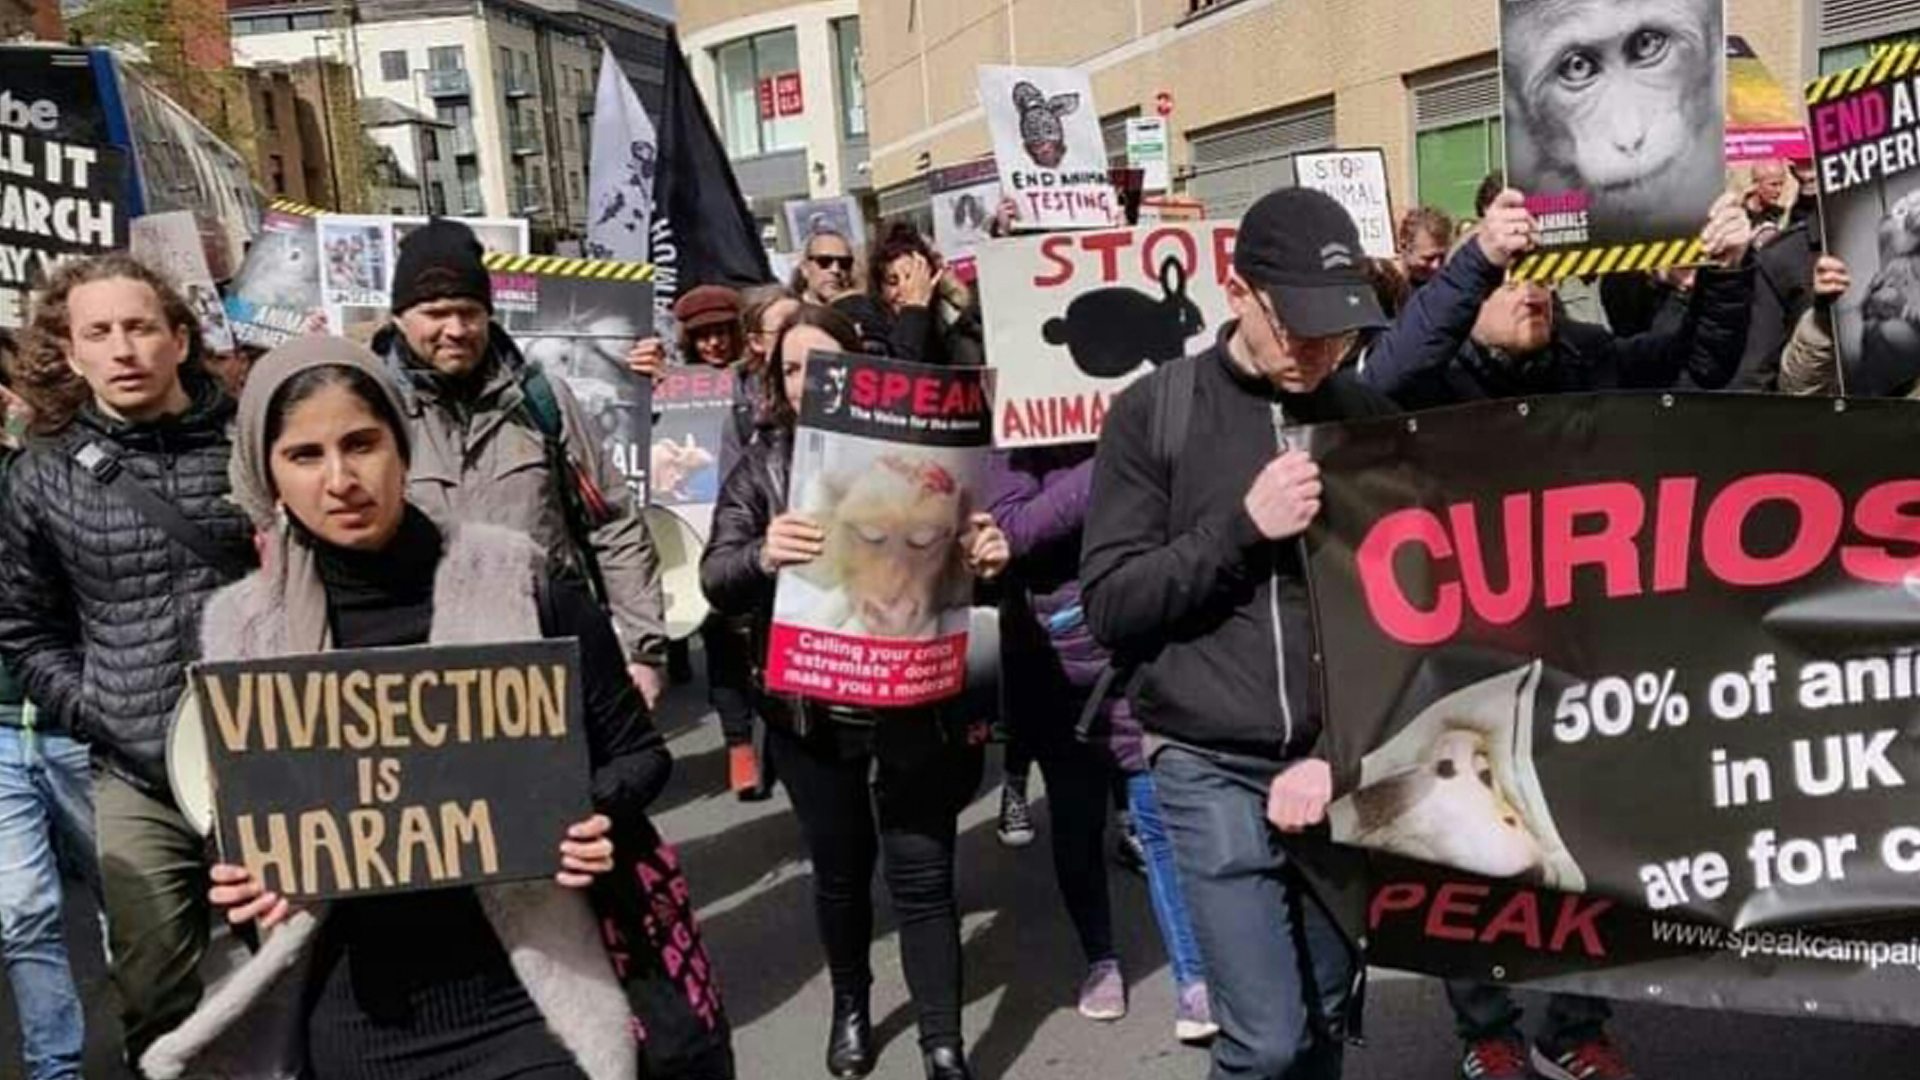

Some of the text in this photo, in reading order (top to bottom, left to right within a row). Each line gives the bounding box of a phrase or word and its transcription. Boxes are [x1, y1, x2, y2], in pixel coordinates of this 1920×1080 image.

[1815, 76, 1920, 151] END A
[46, 141, 97, 188] IT
[1012, 170, 1055, 189] END
[1315, 157, 1364, 179] STOP
[0, 184, 114, 247] ARCH
[1026, 190, 1112, 222] TESTING
[1003, 389, 1112, 438] ANIMA
[799, 633, 864, 661] Calling
[868, 647, 910, 663] your
[206, 664, 566, 753] VIVISECTION
[783, 668, 832, 689] make
[837, 677, 874, 696] you
[878, 683, 890, 697] a
[1553, 667, 1689, 743] 50%
[1708, 653, 1777, 720] of
[357, 757, 400, 804] IS
[1712, 729, 1905, 808] in UK
[236, 799, 499, 896] HARAM
[1639, 851, 1729, 911] are
[1747, 829, 1857, 889] for
[1369, 883, 1612, 957] PEAK
